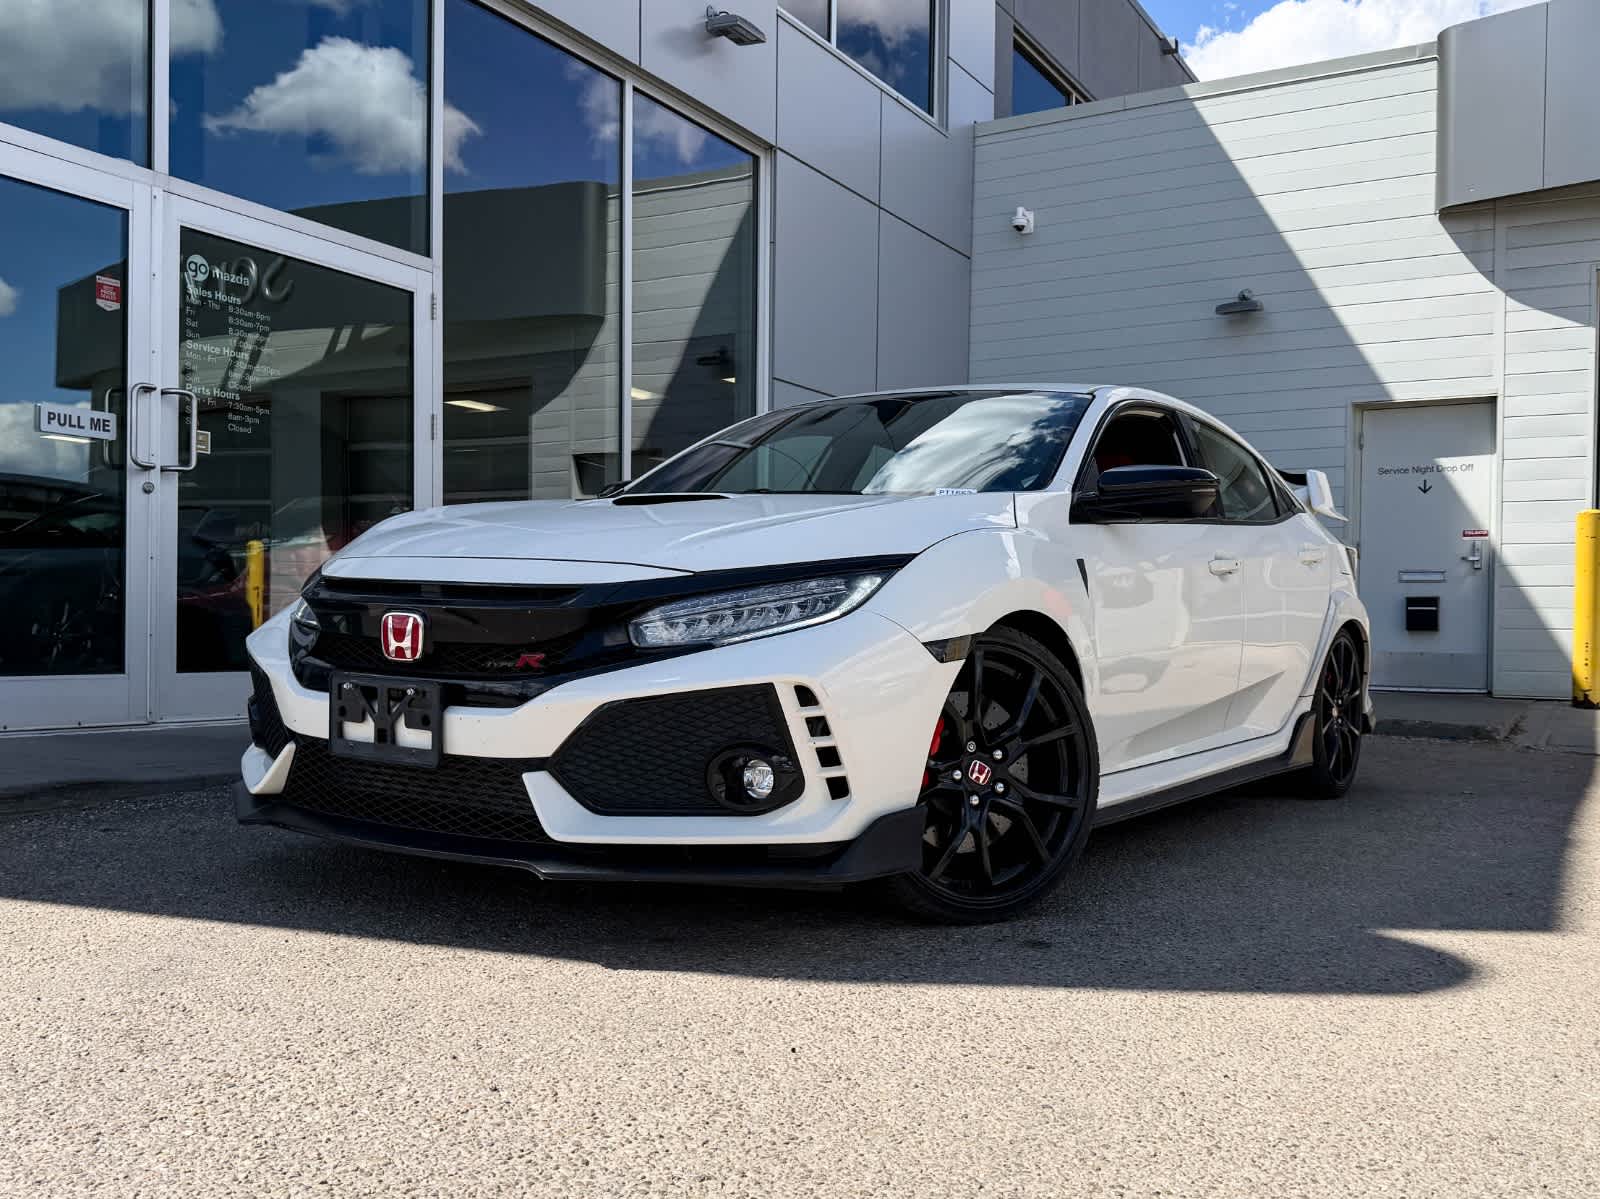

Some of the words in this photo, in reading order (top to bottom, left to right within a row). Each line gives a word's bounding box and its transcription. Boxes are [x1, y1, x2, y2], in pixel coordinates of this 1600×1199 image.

[188, 261, 208, 278] go
[212, 269, 250, 286] mazda
[214, 291, 241, 305] Hours
[186, 318, 198, 328] Sat
[186, 340, 220, 354] Service
[223, 346, 249, 361] Hours
[186, 383, 211, 395] Parts
[213, 387, 241, 401] Hours
[47, 411, 85, 430] PULL
[90, 417, 111, 432] ME
[1377, 466, 1410, 476] Service
[1412, 464, 1435, 475] Night
[1436, 464, 1458, 474] Drop
[1460, 463, 1475, 473] Off
